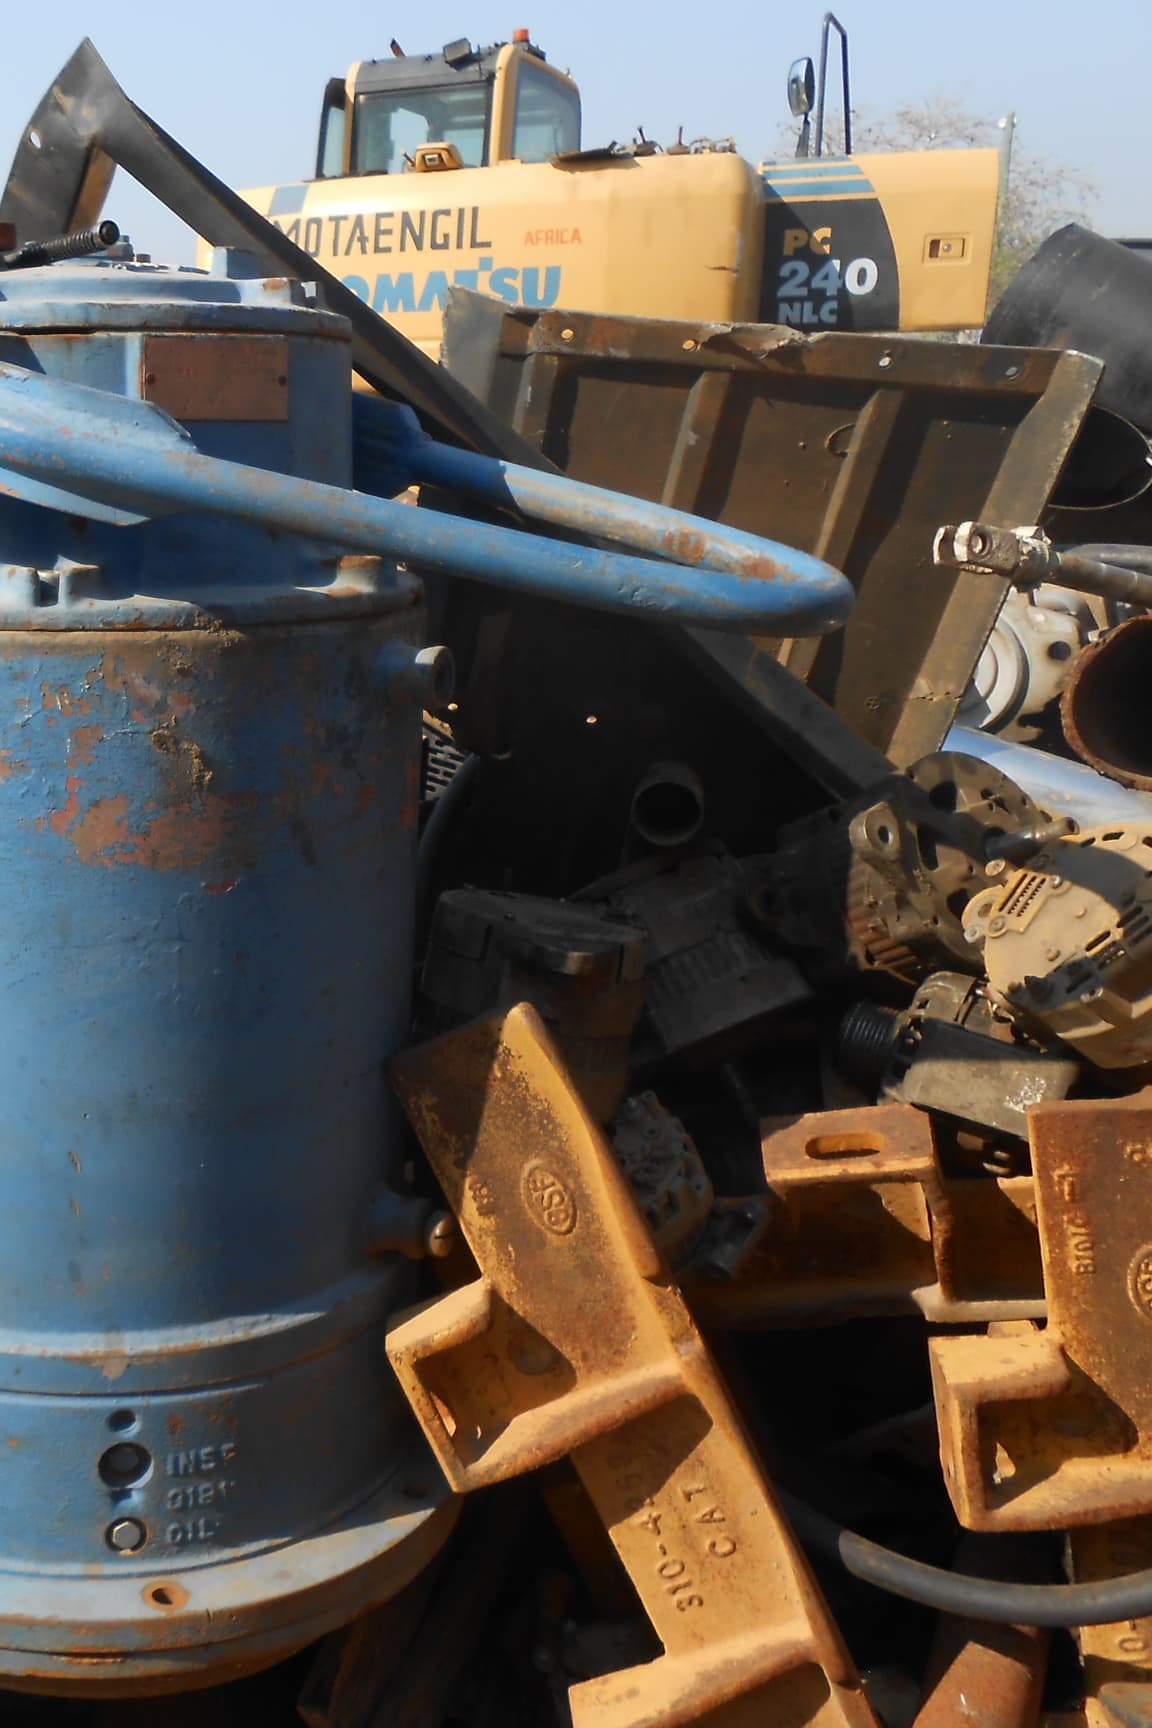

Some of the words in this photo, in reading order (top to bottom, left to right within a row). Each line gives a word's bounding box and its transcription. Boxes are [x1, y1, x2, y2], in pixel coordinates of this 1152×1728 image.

[524, 228, 583, 246] AFRICA
[783, 227, 833, 256] PC
[342, 257, 562, 313] OMATSU
[776, 257, 879, 298] 240
[777, 300, 838, 324] NLC
[680, 1484, 736, 1558] CAT
